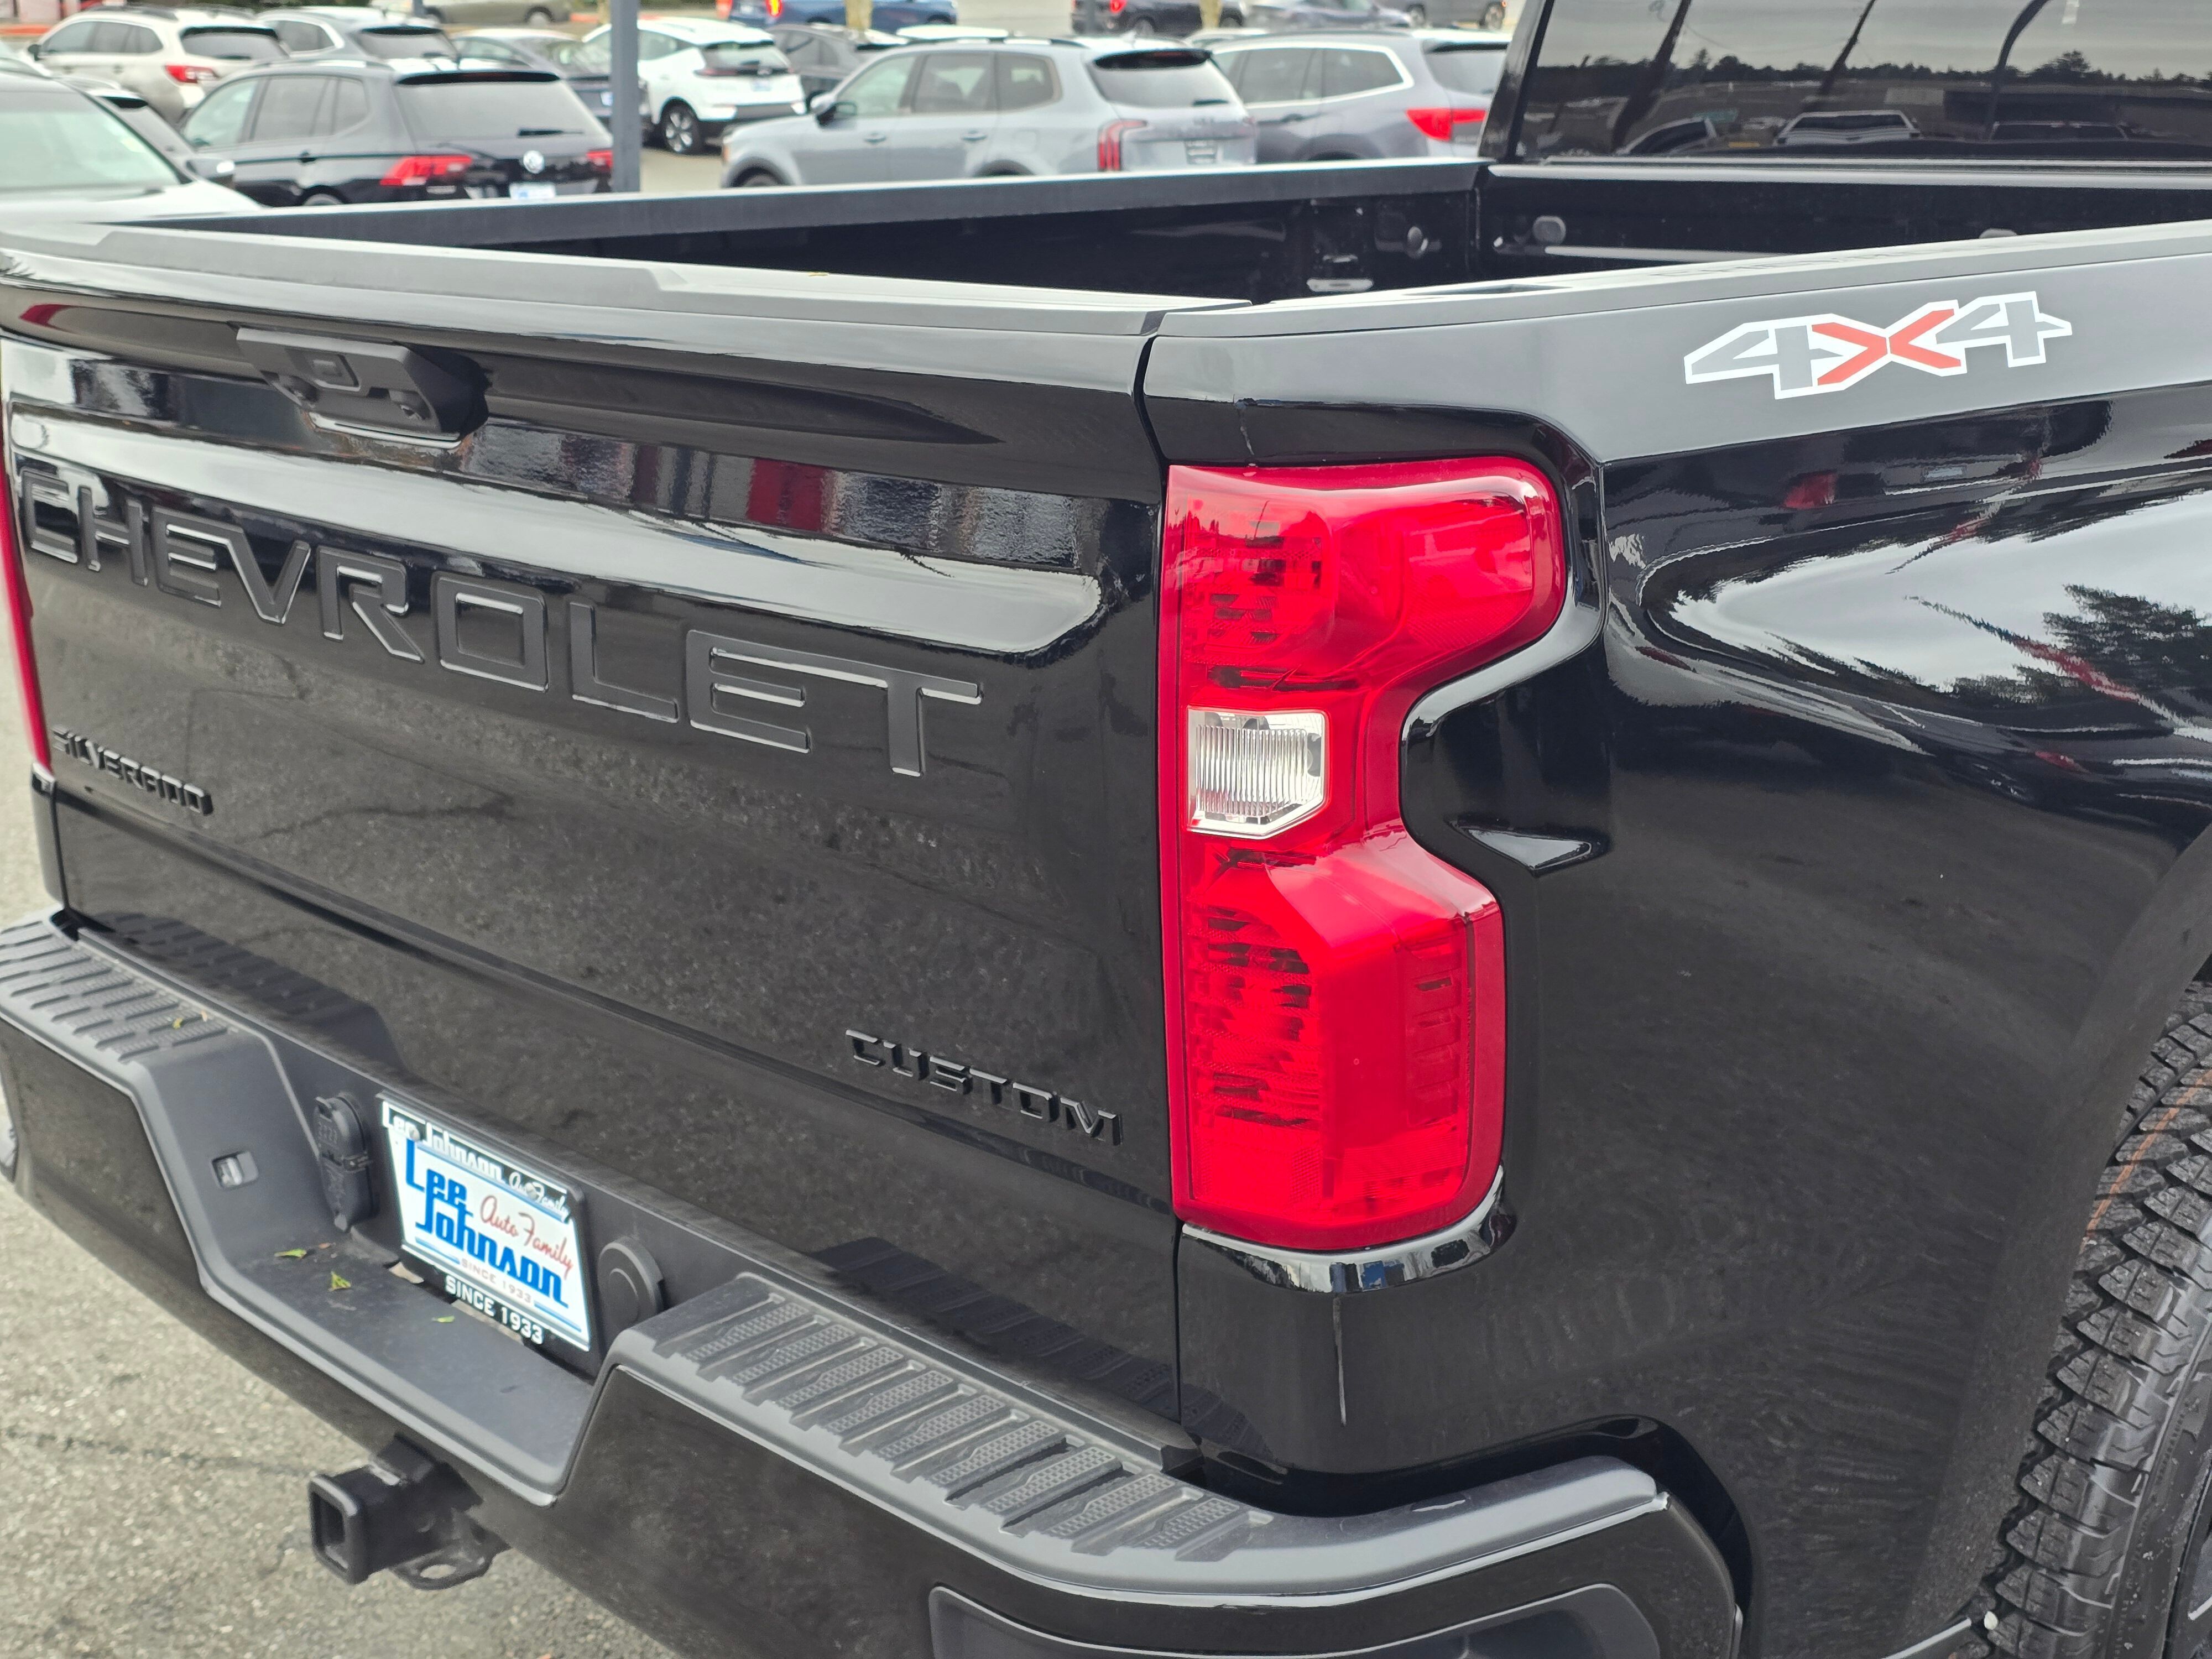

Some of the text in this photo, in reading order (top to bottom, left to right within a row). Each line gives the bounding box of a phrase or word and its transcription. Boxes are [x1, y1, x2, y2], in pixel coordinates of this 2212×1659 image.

[1684, 291, 2072, 399] 4X4
[20, 468, 983, 777] CHEVROLET
[51, 725, 214, 816] SILVERADO
[846, 1029, 1123, 1146] CUSTOM
[405, 1138, 473, 1217] Lee
[415, 1196, 569, 1309] Johnson
[461, 1258, 532, 1303] SINCE 1933
[480, 1194, 573, 1281] Auto Family
[445, 1274, 544, 1345] SINCE 1933
